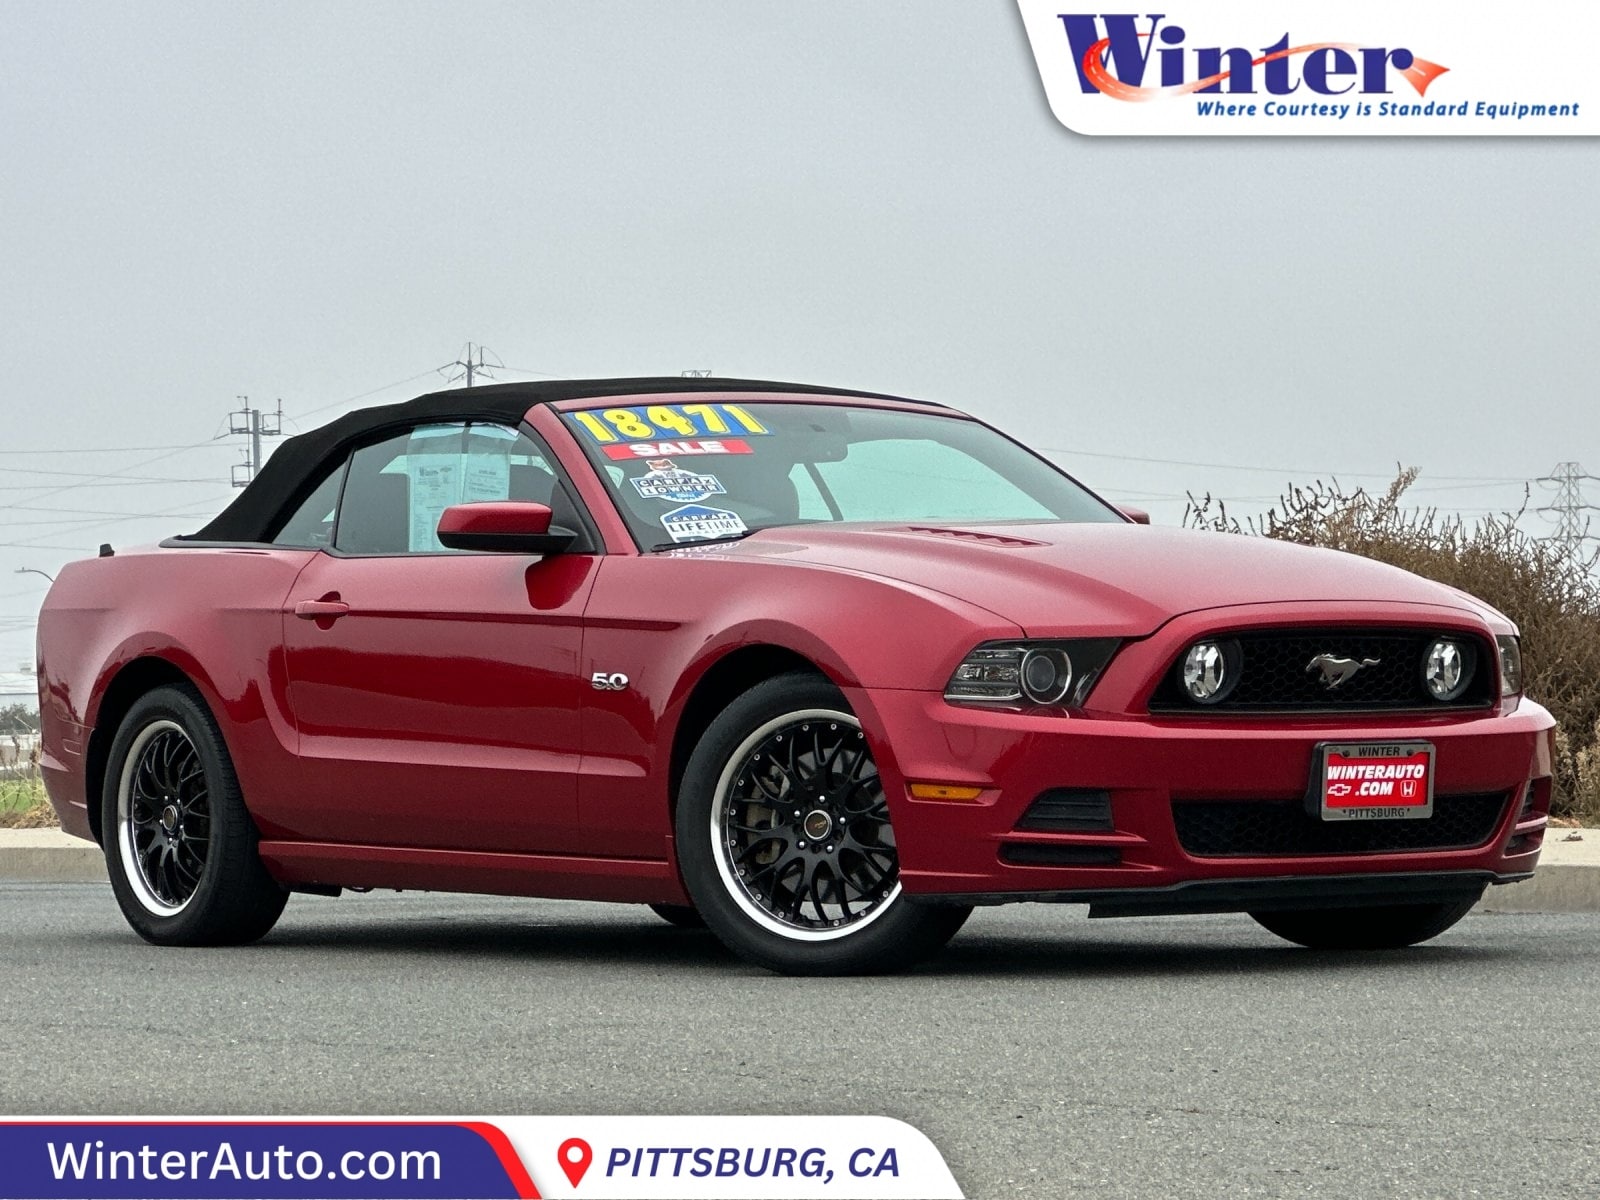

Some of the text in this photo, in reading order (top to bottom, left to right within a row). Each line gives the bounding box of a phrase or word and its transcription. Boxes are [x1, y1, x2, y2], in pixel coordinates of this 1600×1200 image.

[574, 404, 770, 442] 18471
[629, 441, 726, 456] SALE
[639, 476, 716, 487] CARFAX
[668, 520, 741, 532] LIFETIME
[1359, 746, 1400, 756] WINTER
[1327, 764, 1424, 780] WINTERAUTO
[1355, 782, 1394, 796] .COM
[1349, 808, 1405, 818] PITTSBURG
